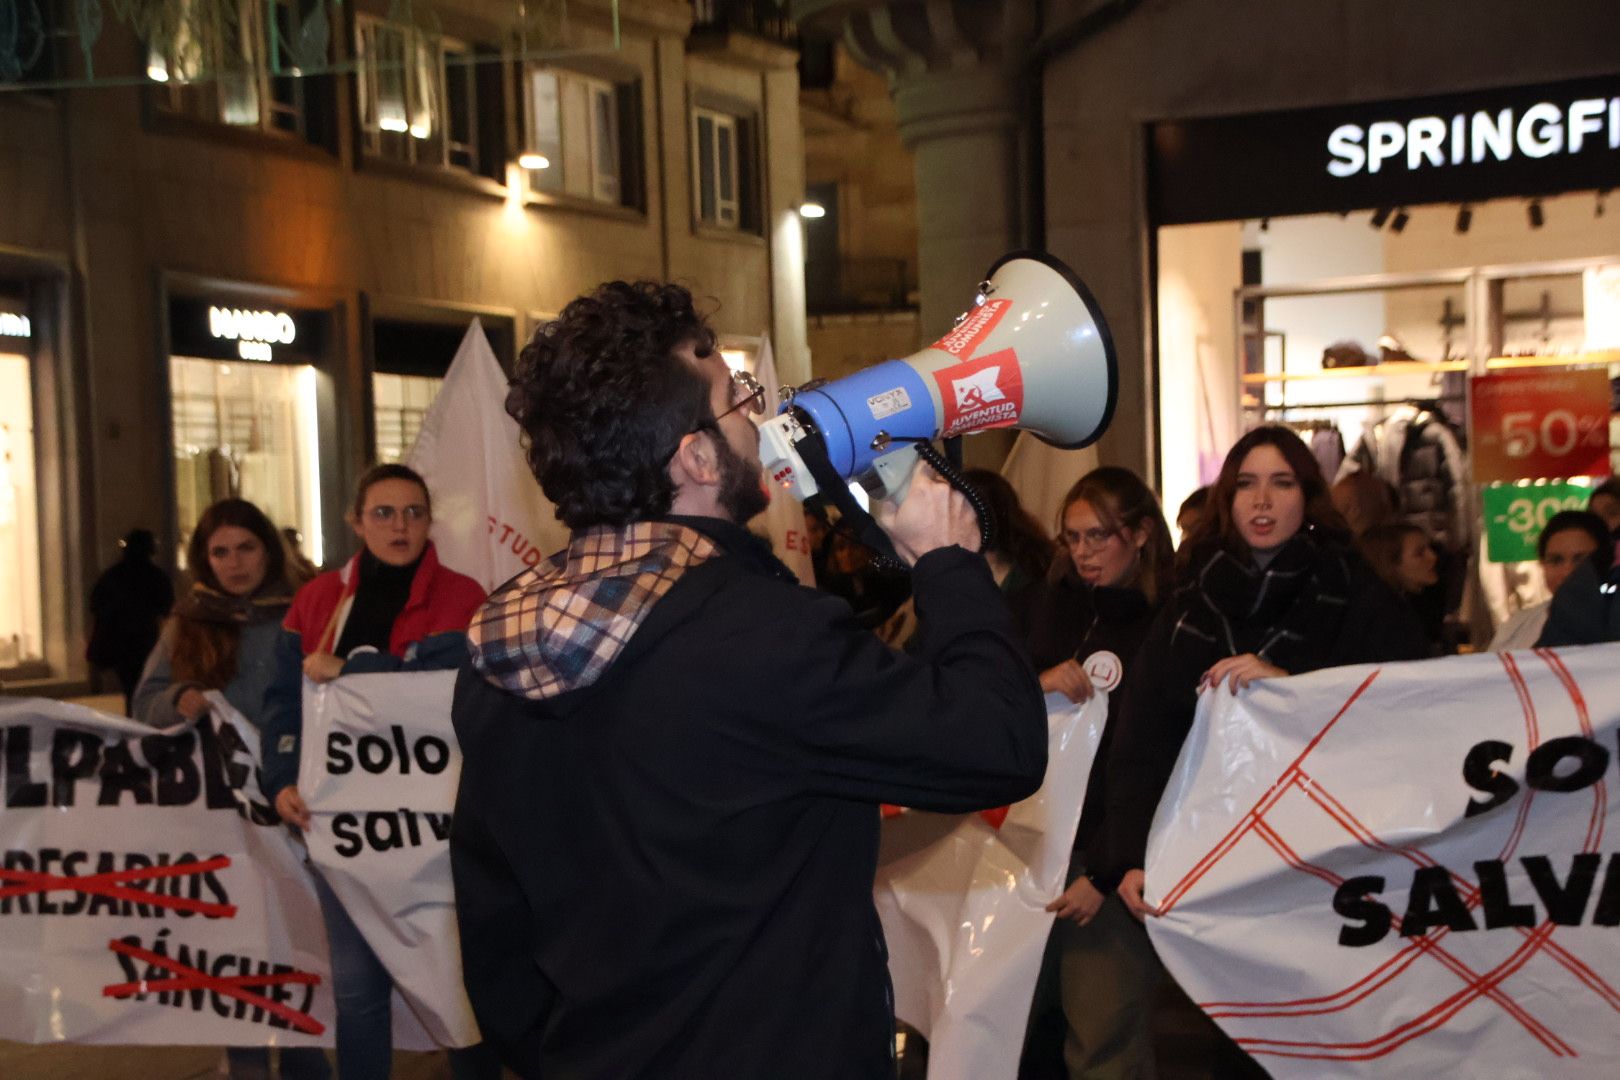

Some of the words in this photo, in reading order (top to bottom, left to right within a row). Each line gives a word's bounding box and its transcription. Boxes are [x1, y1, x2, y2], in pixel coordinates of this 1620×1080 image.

[950, 402, 1016, 430] JUVENTUD
[326, 724, 450, 776] solo
[1462, 728, 1620, 818] SO
